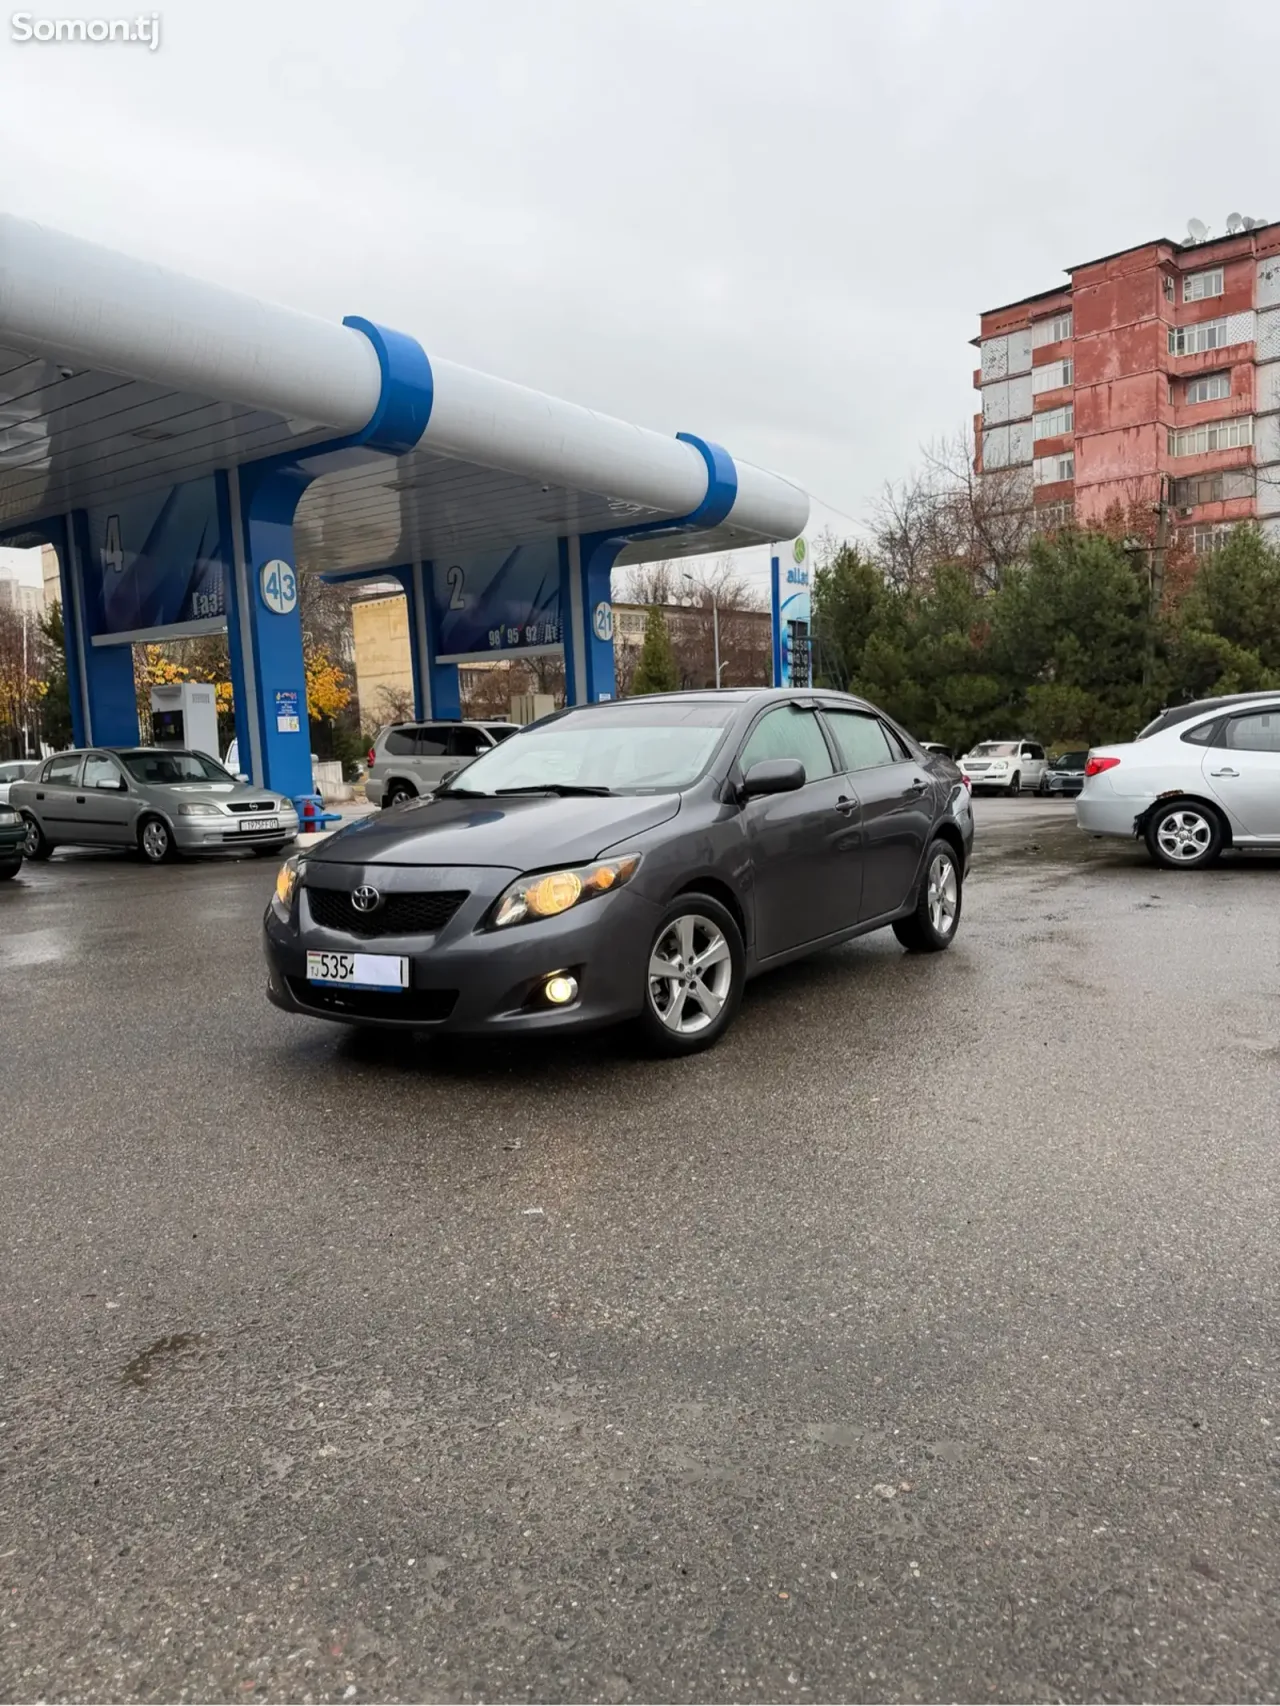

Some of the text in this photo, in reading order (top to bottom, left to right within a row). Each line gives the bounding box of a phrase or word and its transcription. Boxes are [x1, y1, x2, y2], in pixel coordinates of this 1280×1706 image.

[106, 514, 124, 573] 4
[447, 565, 465, 611] 2
[507, 627, 519, 644] 95
[525, 625, 537, 642] 92
